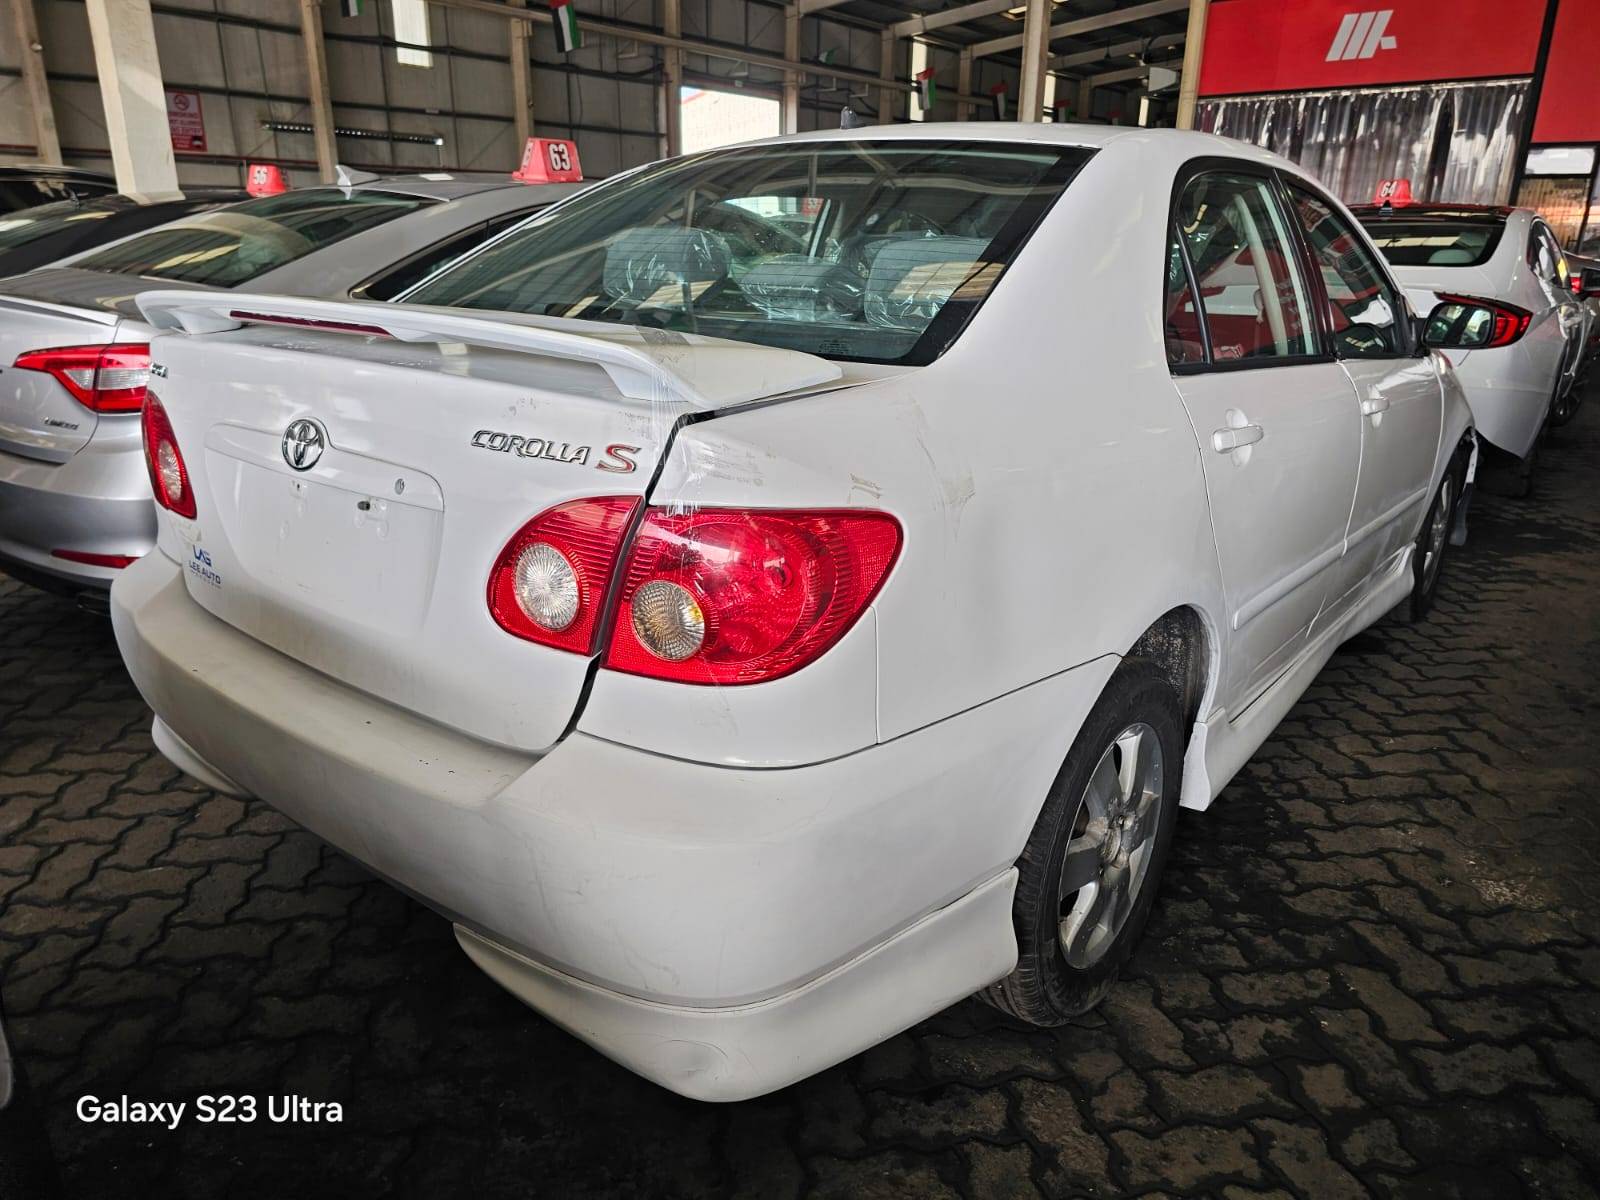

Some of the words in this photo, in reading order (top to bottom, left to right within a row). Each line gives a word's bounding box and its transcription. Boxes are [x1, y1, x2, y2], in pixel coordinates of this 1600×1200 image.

[548, 143, 572, 171] 63
[253, 165, 268, 185] 56
[1380, 180, 1398, 197] 64
[471, 429, 591, 465] COROLLA
[595, 443, 642, 474] S
[201, 567, 221, 585] AUTO
